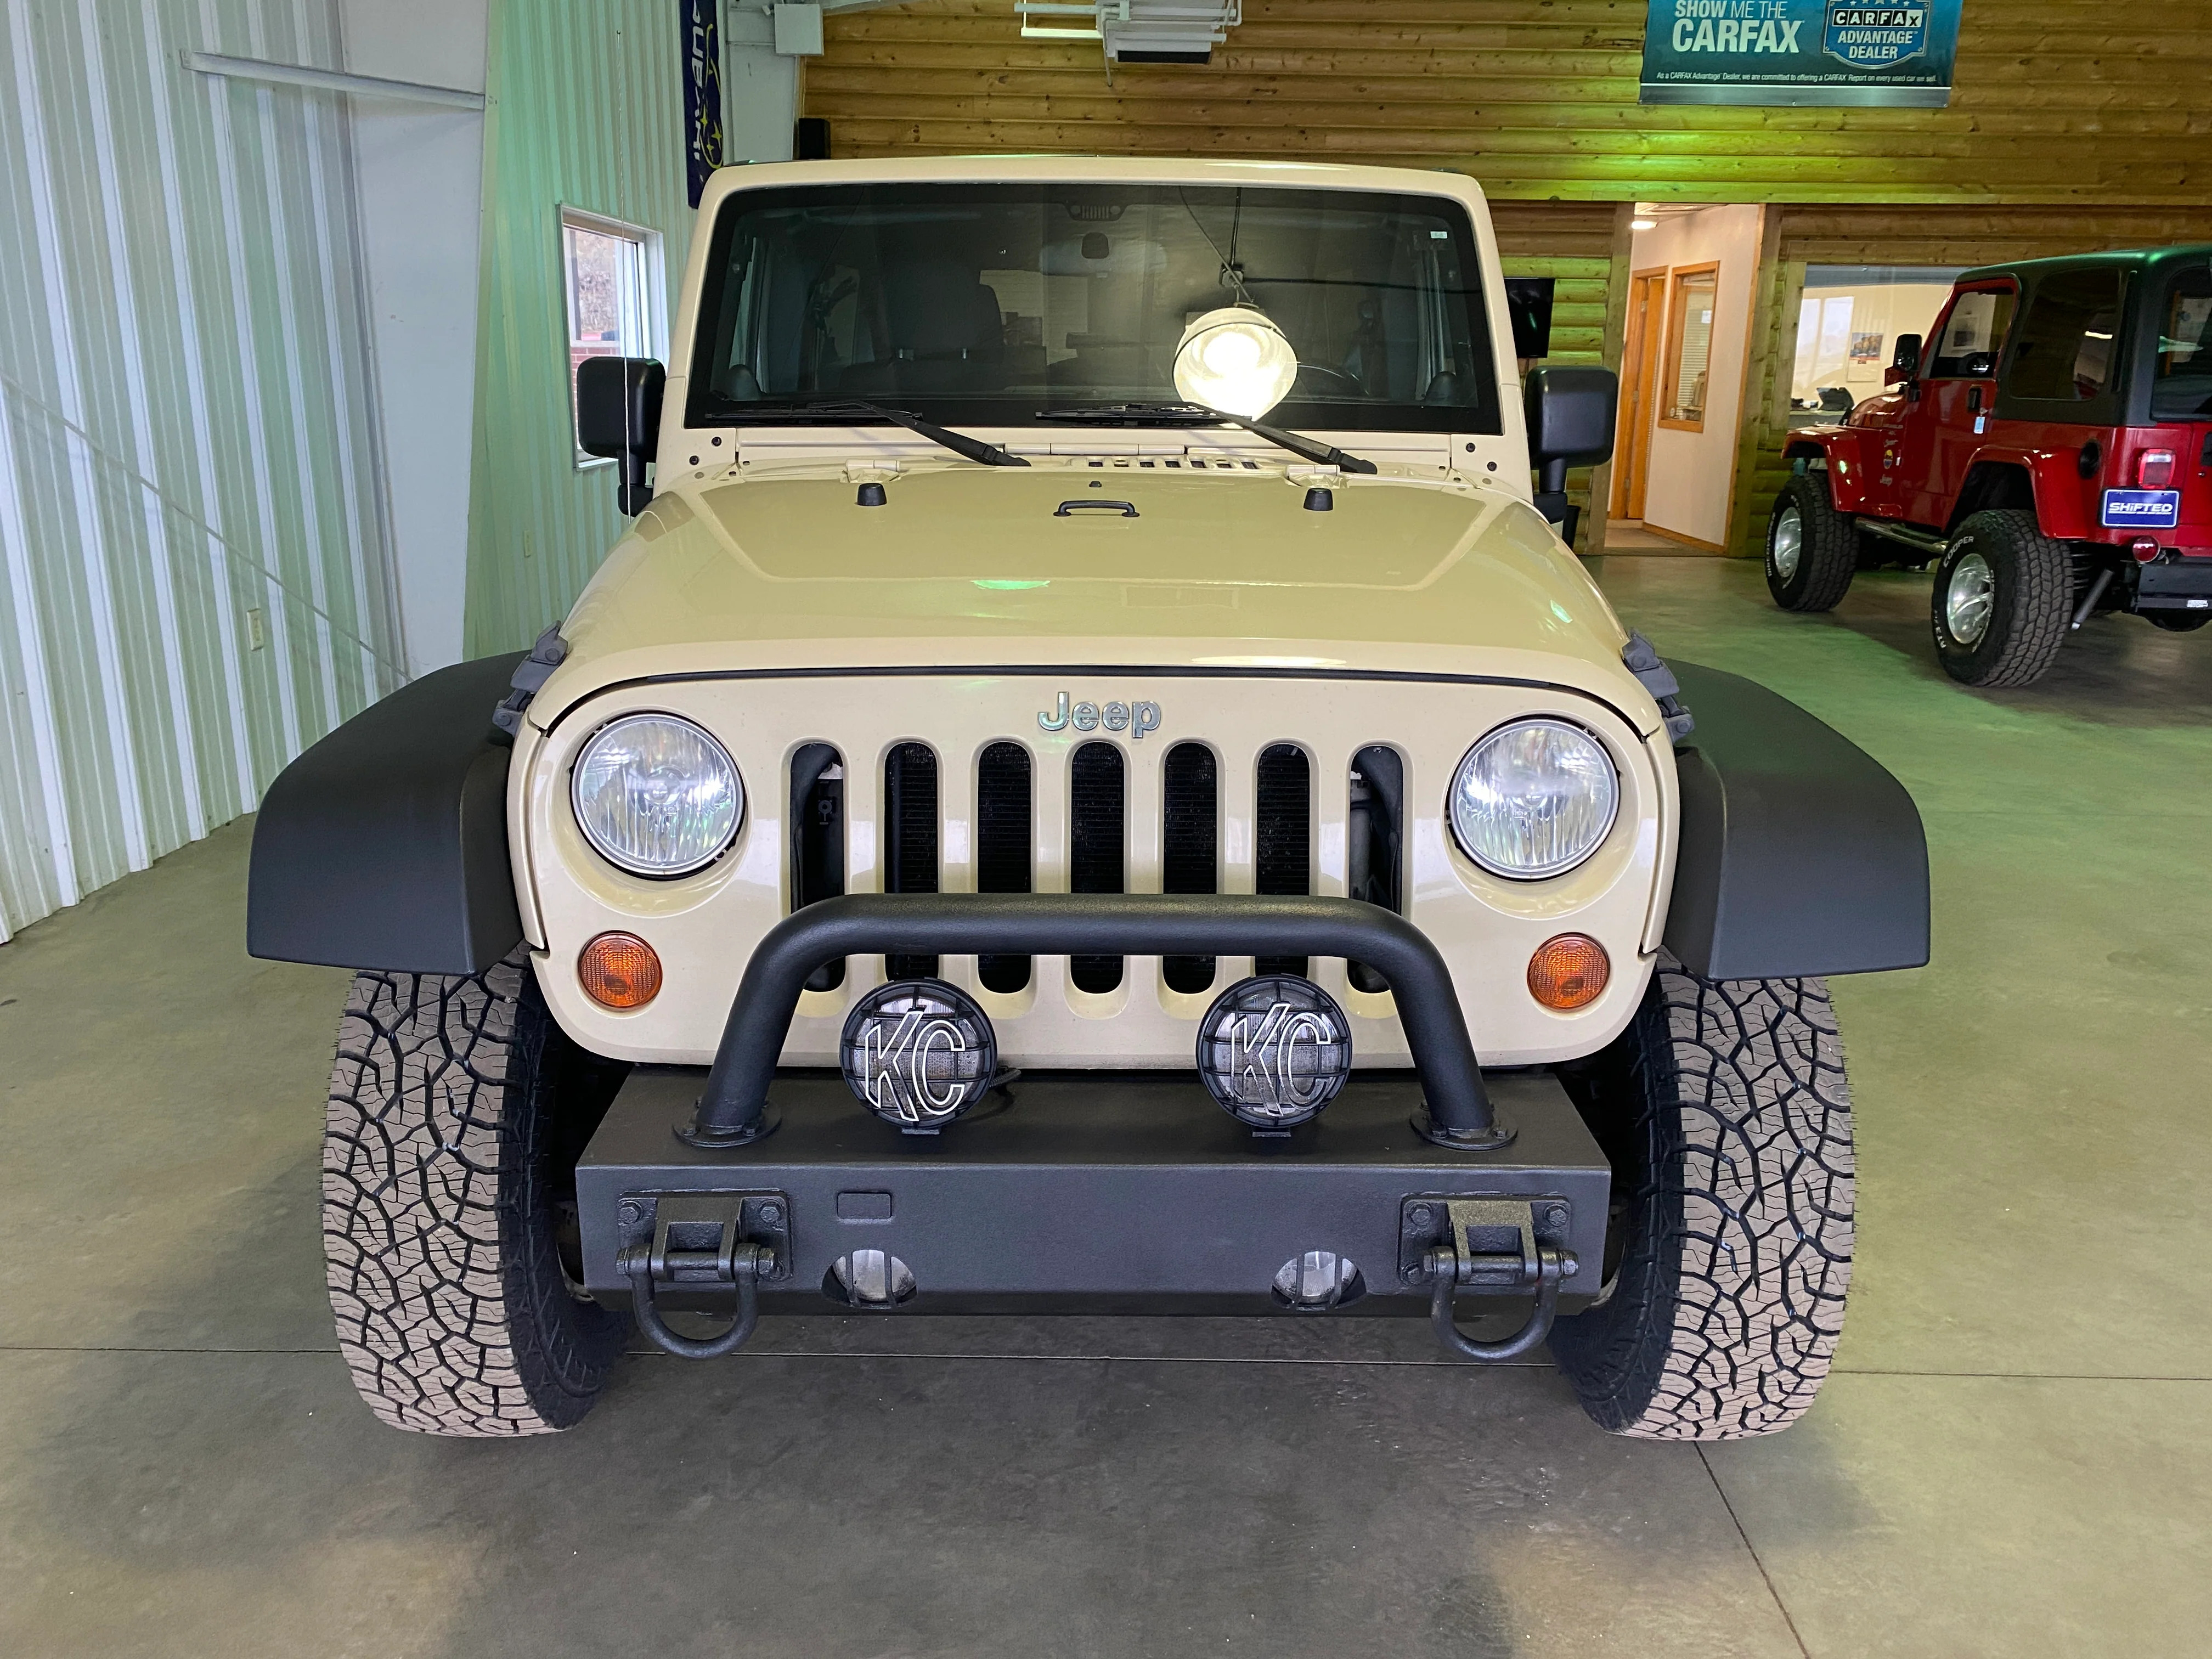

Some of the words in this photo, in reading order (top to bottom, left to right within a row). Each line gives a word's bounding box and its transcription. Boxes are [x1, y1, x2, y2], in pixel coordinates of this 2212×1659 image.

[1674, 0, 1728, 18] SHOW
[1731, 1, 1755, 18] ME
[1759, 1, 1788, 19] THE
[1836, 12, 1920, 26] CARFAX
[1673, 18, 1803, 53] CARFAX
[1838, 30, 1913, 44] ADVANTAGE
[1849, 46, 1898, 59] DEALER
[1797, 74, 1818, 82] offering
[1848, 74, 1867, 82] Report
[1943, 535, 1974, 568] COOPER
[1037, 691, 1161, 738] Jeep
[865, 1011, 966, 1121] KC
[1231, 1003, 1331, 1117] KC
